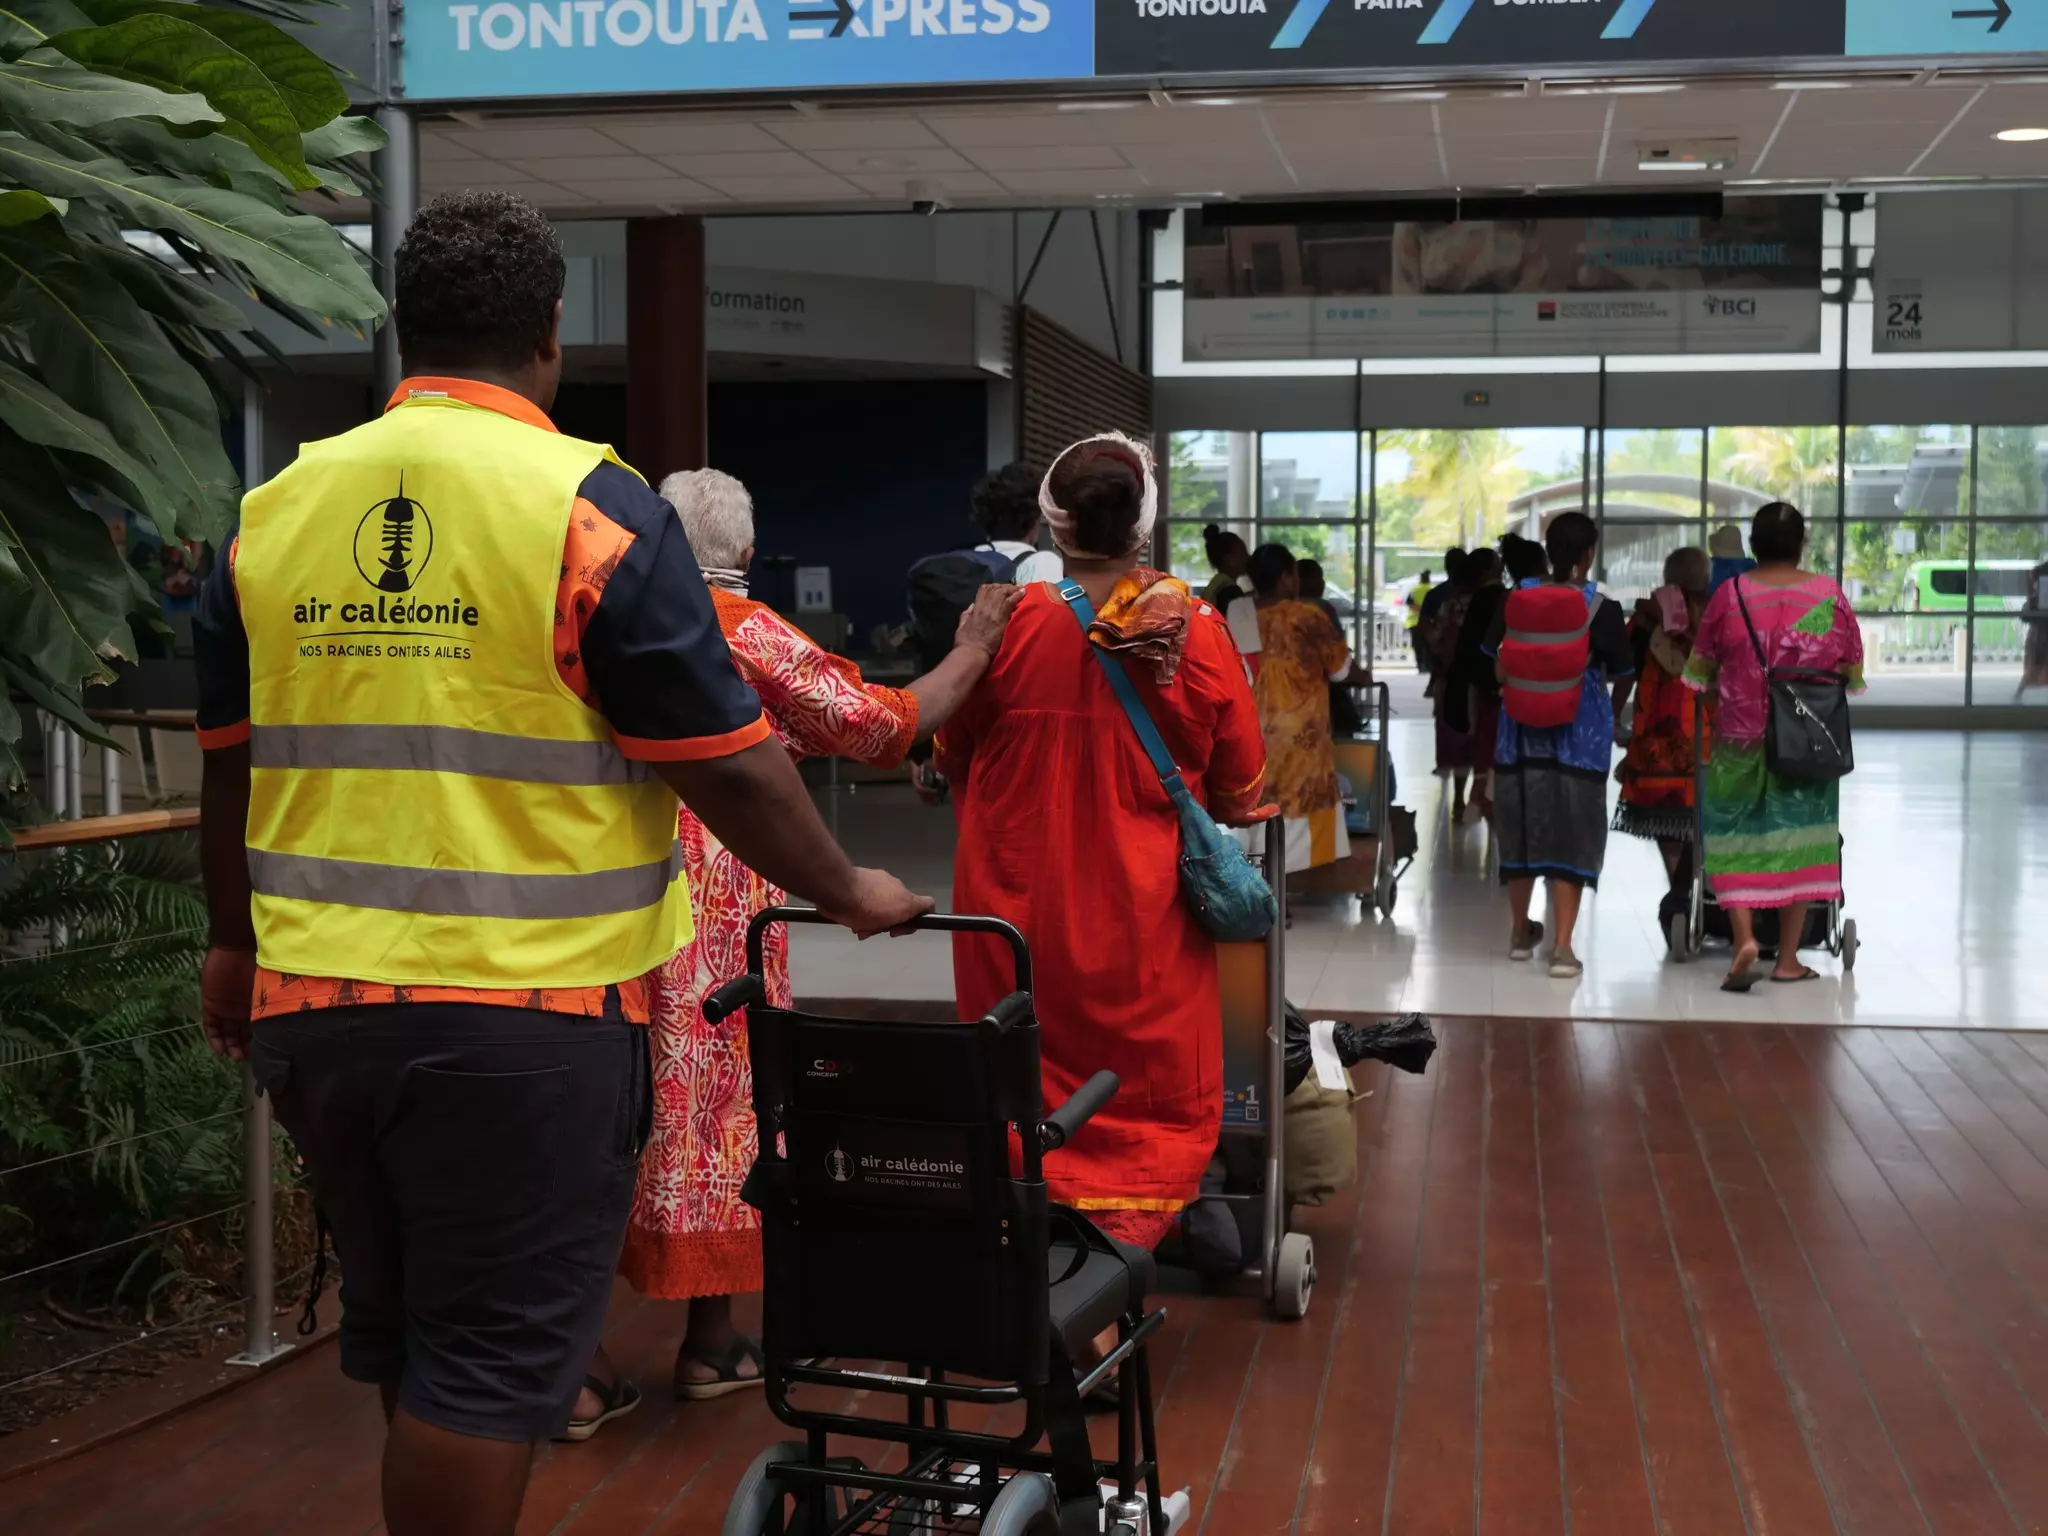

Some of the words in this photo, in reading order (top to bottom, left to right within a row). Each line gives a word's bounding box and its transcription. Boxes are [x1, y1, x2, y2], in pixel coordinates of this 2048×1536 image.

[1135, 0, 1267, 17] TONTOUTA
[448, 0, 769, 51] TONTOUTA
[788, 0, 1051, 39] EXPRESS
[1722, 299, 1756, 315] BCI
[1887, 301, 1923, 326] 24
[1886, 326, 1922, 340] mois
[293, 597, 332, 624] air
[340, 595, 479, 626] calédonie
[299, 645, 322, 657] NOS
[327, 645, 382, 657] RACINES
[387, 645, 411, 658] ONT
[411, 646, 430, 657] DES
[434, 646, 471, 659] AILES
[861, 1155, 881, 1169] air
[885, 1157, 964, 1174] calédonie
[864, 1176, 879, 1184] NOS
[881, 1177, 909, 1186] RACINES
[911, 1179, 925, 1187] ONT
[928, 1180, 941, 1188] DES
[942, 1181, 962, 1189] AILES
